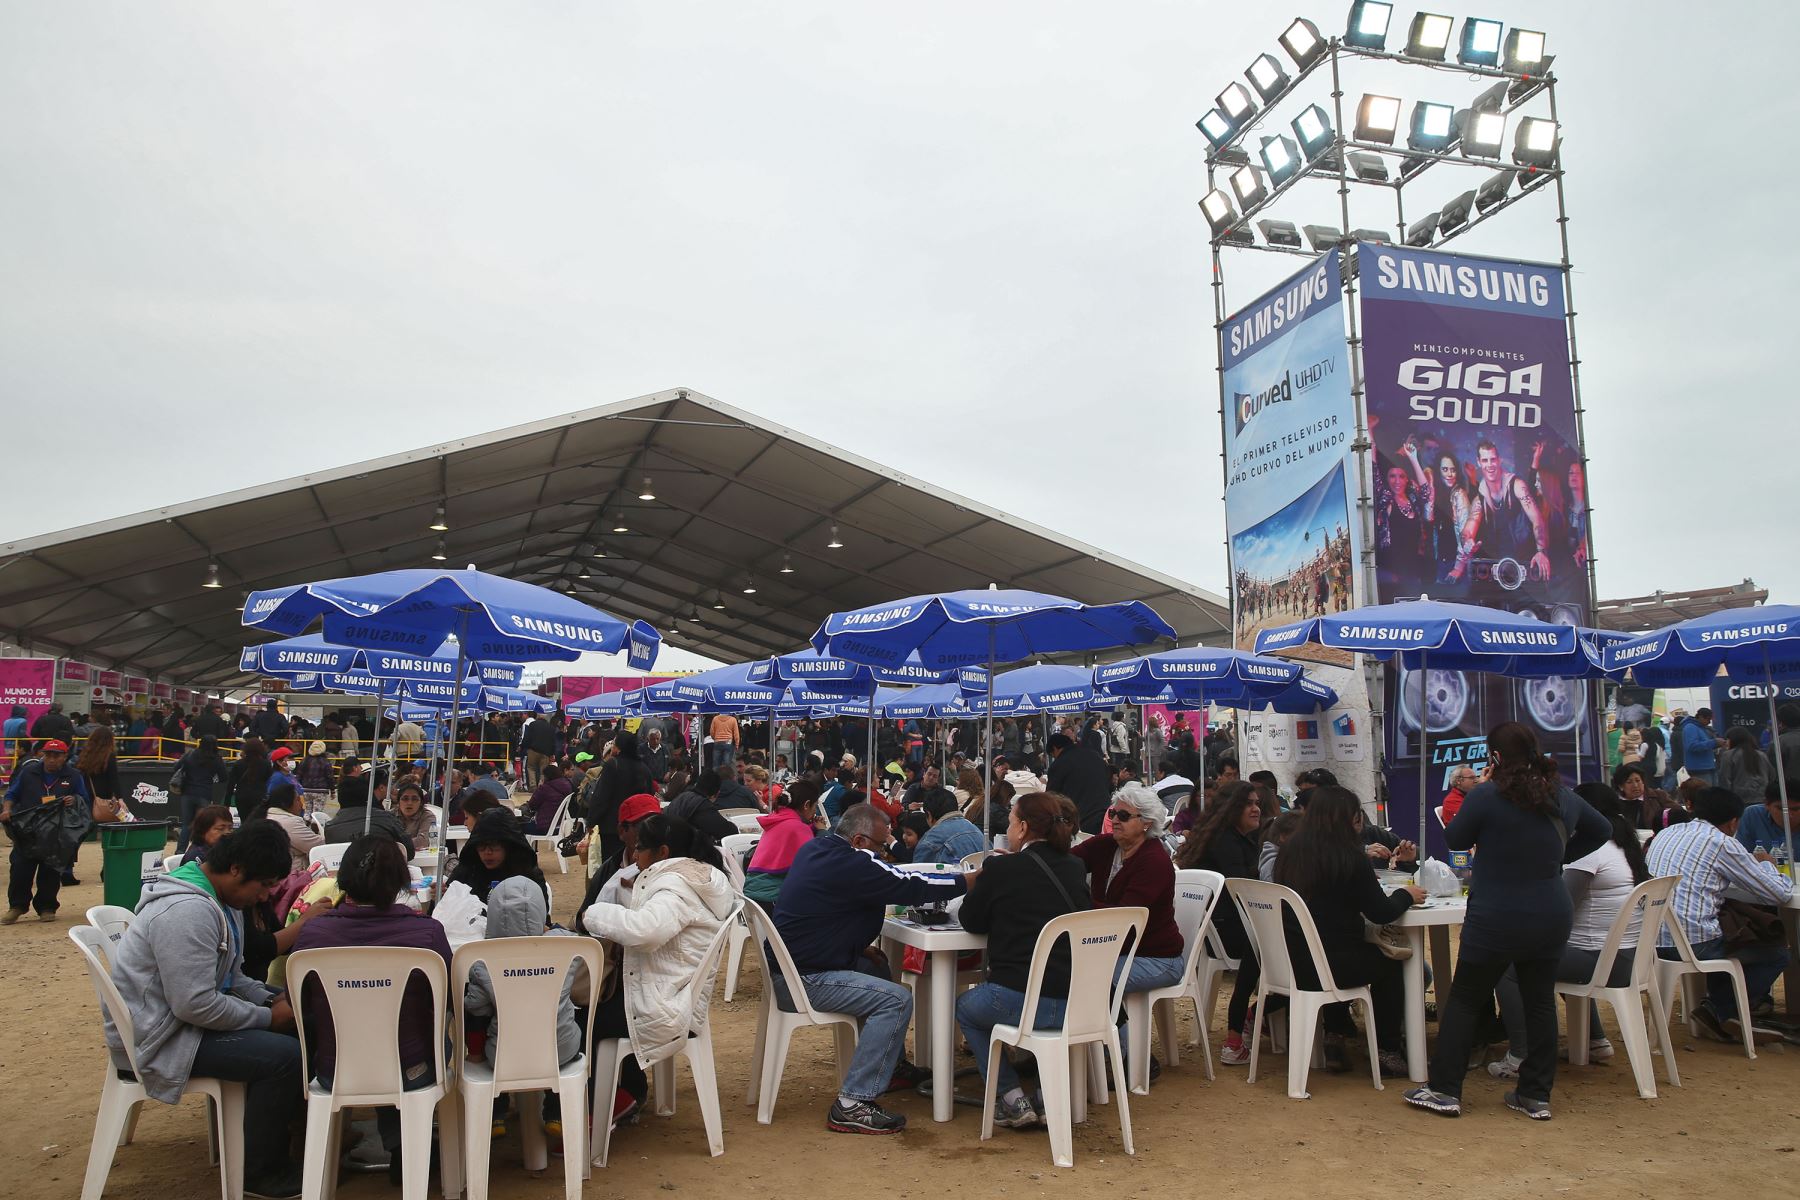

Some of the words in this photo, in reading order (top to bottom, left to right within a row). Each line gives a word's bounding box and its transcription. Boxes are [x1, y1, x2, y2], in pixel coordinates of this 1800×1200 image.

[1377, 255, 1548, 307] SAMSUNG
[1231, 266, 1328, 357] SAMSUNG
[1414, 343, 1525, 362] MINICOMPONENTES
[1397, 357, 1543, 397] GIGA
[1243, 440, 1278, 463] PRIMER
[1281, 415, 1338, 447] TELEVISOR
[1250, 458, 1281, 478] CURVO
[1286, 450, 1304, 465] DEL
[1308, 432, 1345, 455] MUNDO
[843, 606, 911, 626] SAMSUNG
[511, 615, 603, 643] SAMSUNG
[1340, 625, 1424, 641] SAMSUNG
[1701, 623, 1788, 642] SAMSUNG
[1264, 628, 1302, 645] SAMSUNG
[1481, 630, 1558, 646] SAMSUNG
[1615, 641, 1659, 661] SAMSUNG
[278, 651, 338, 666] SAMSUNG
[381, 657, 452, 674] SAMSUNG
[791, 660, 846, 673] SAMSUNG
[1102, 665, 1136, 677] SAMSUNG
[1162, 663, 1217, 672] SAMSUNG
[1248, 664, 1290, 678] SAMSUNG
[334, 674, 387, 687] SAMSUN
[483, 667, 515, 681] SAMSUNG
[962, 671, 987, 683] SAMSUNG
[4, 688, 33, 696] MUNDO
[417, 684, 467, 696] SAMSUG
[679, 686, 703, 697] SAMSUNG
[725, 691, 772, 700] SAMSUNG
[1040, 690, 1084, 703] SAMSUNG
[1728, 684, 1779, 699] CIELO
[841, 705, 869, 714] SAMSUNG
[976, 698, 1014, 708] SASUNG
[1432, 746, 1464, 764] LAS
[1081, 935, 1117, 945] SAMSUNG
[503, 967, 555, 977] SAMSUNG
[337, 978, 392, 988] SAMSUNG
